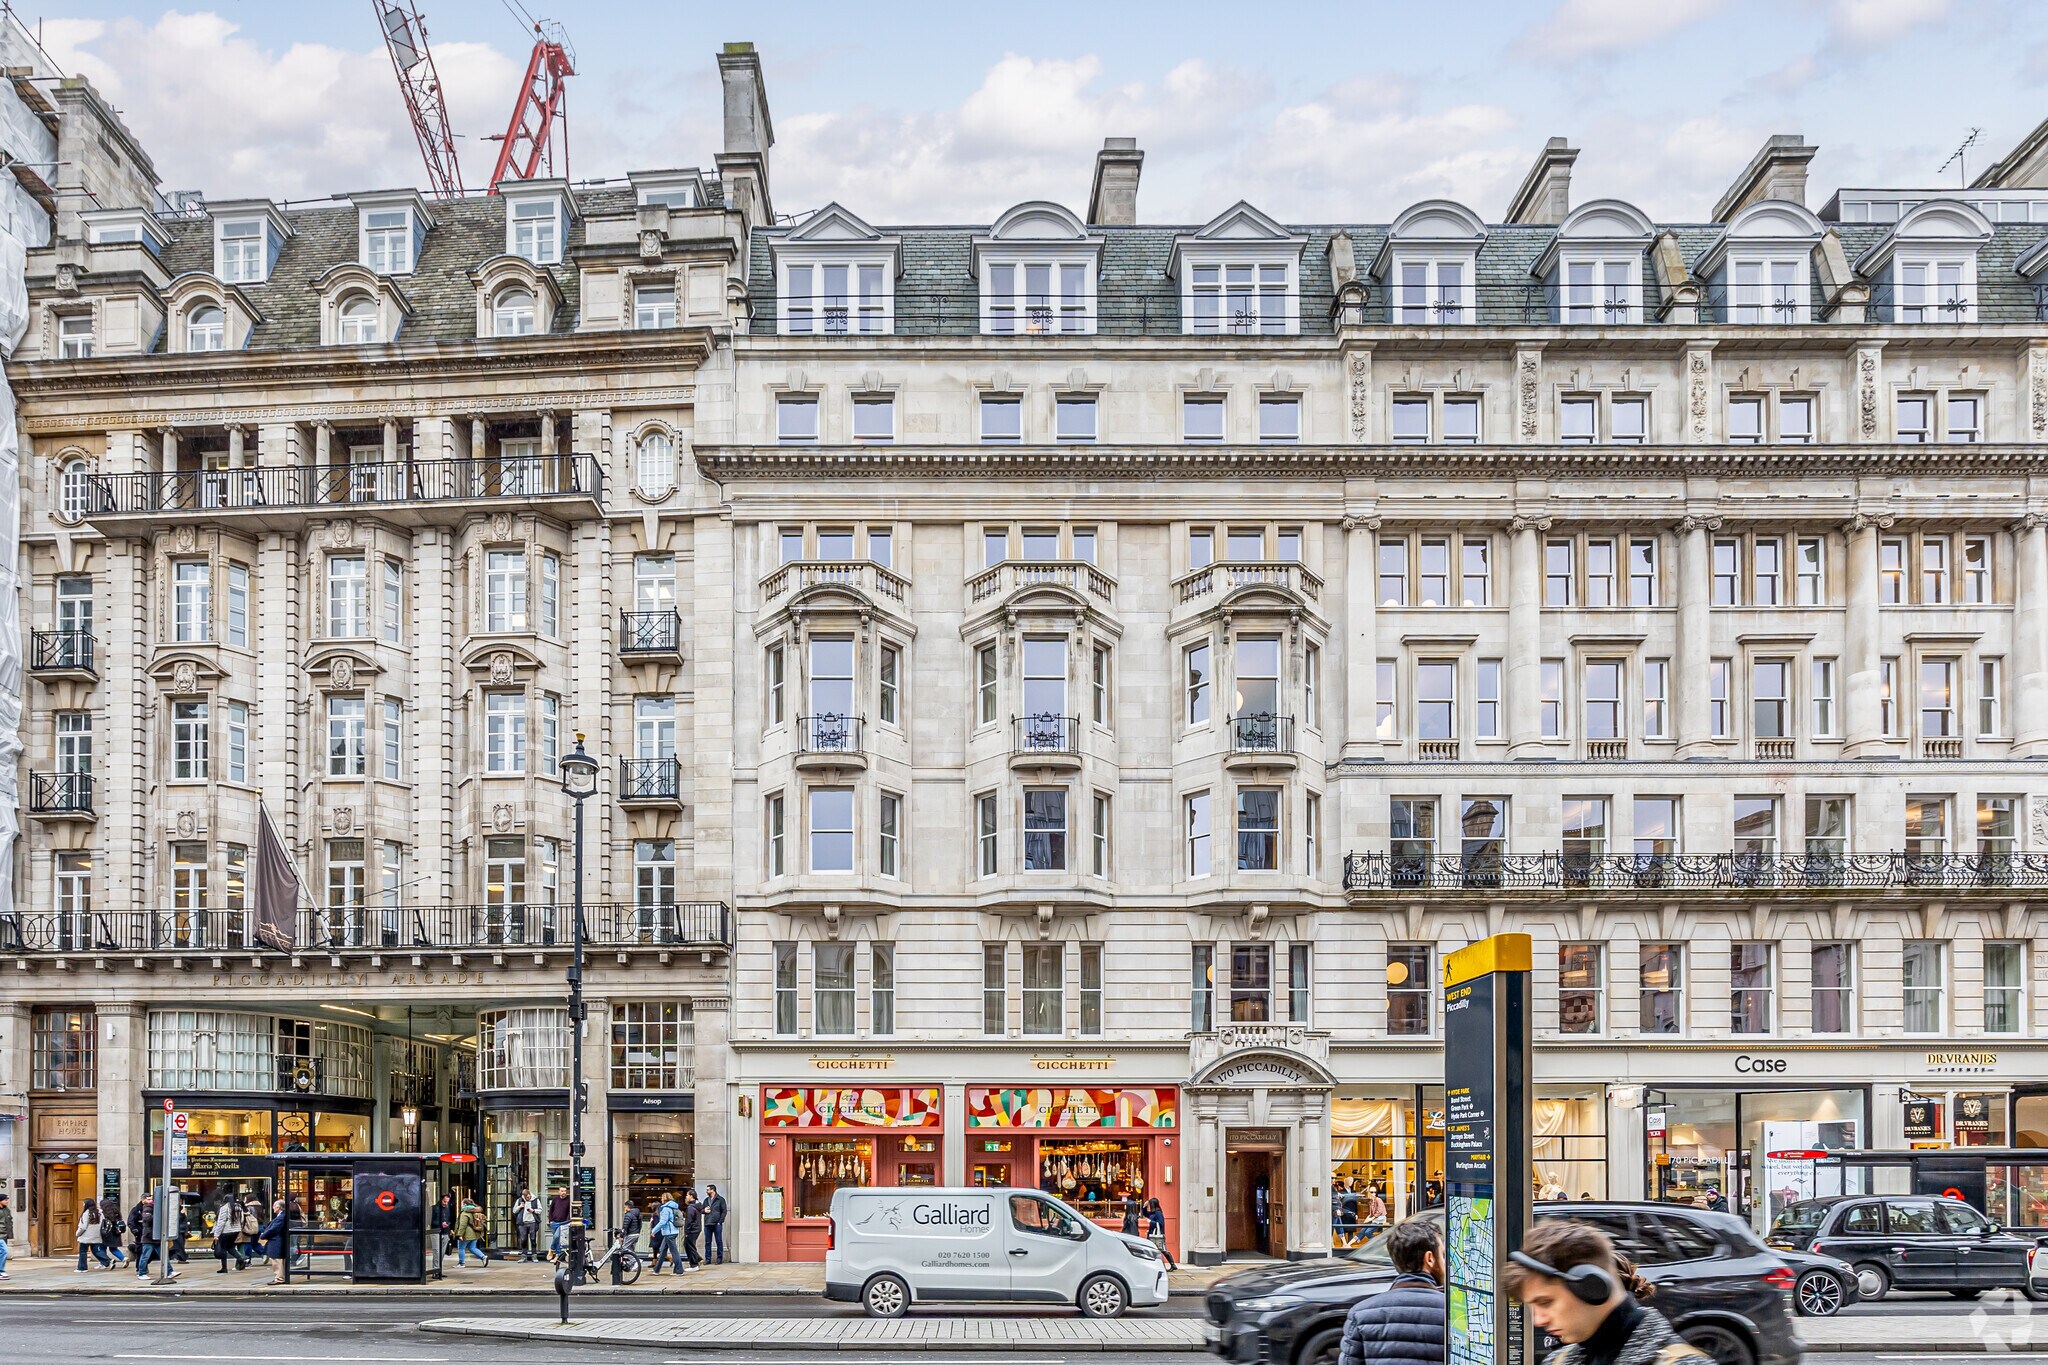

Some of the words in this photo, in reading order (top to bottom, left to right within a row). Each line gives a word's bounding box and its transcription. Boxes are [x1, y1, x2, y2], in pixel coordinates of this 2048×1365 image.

[213, 974, 364, 986] PICCADILLY
[392, 973, 484, 984] ARCADE
[1446, 990, 1460, 1001] WEST
[1460, 987, 1472, 997] END
[1446, 999, 1469, 1012] Piccadilly
[816, 1061, 888, 1069] CICCHETTI
[1037, 1061, 1109, 1070] CICCHETTI
[1735, 1055, 1787, 1073] Case
[1218, 1069, 1235, 1082] 170
[1236, 1062, 1302, 1082] PICCADILLY
[819, 1105, 883, 1113] CICCHETTI
[1039, 1106, 1103, 1114] CICCHETTI
[913, 1203, 990, 1225] Galliard
[921, 1260, 990, 1268] Galliardhomes.com
